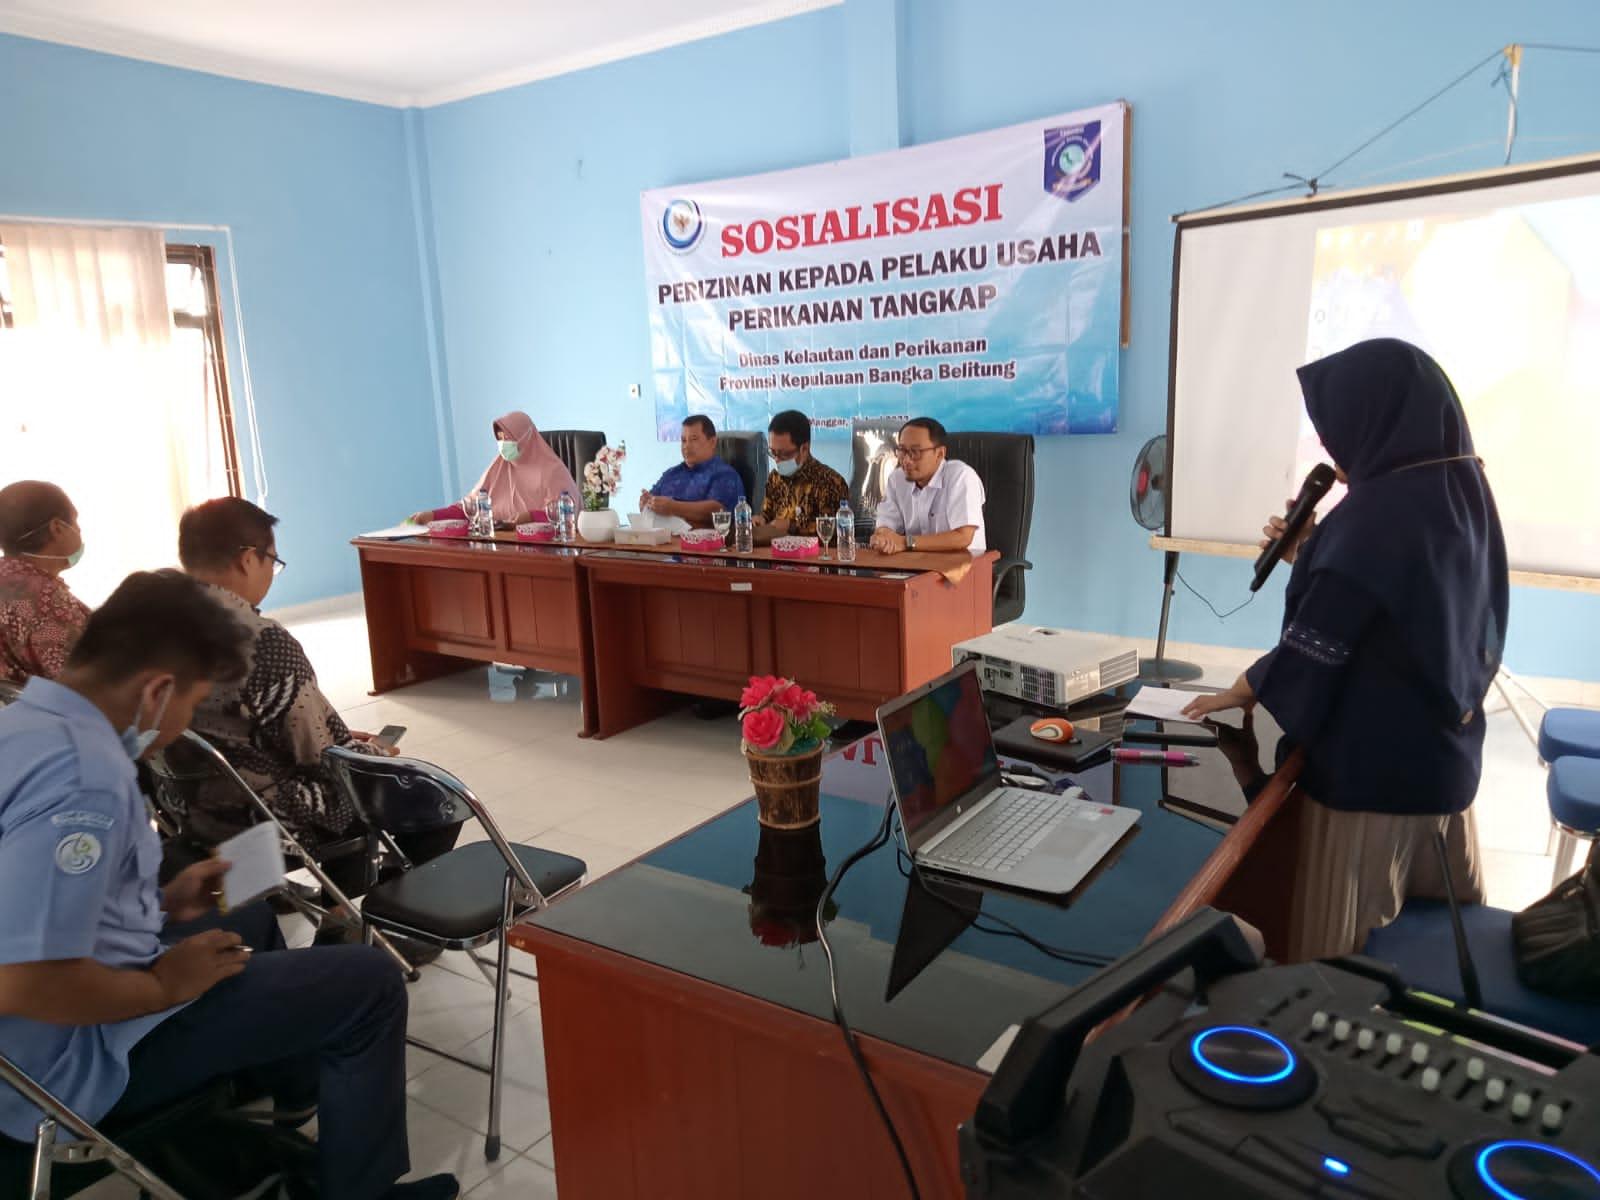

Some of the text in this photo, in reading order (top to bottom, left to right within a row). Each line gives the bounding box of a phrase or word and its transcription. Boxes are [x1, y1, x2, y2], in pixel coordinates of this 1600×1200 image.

[721, 183, 1004, 258] SOSIALISASI
[658, 231, 1102, 305] PERIZINAN KEPADA PELAKU USAHA
[728, 284, 997, 332] PERIKANAN TANGKAP
[719, 360, 1015, 392] Provinsi Kepulauan Bangka Belitung
[738, 338, 986, 368] Dinas Kelautan dan Perikanan
